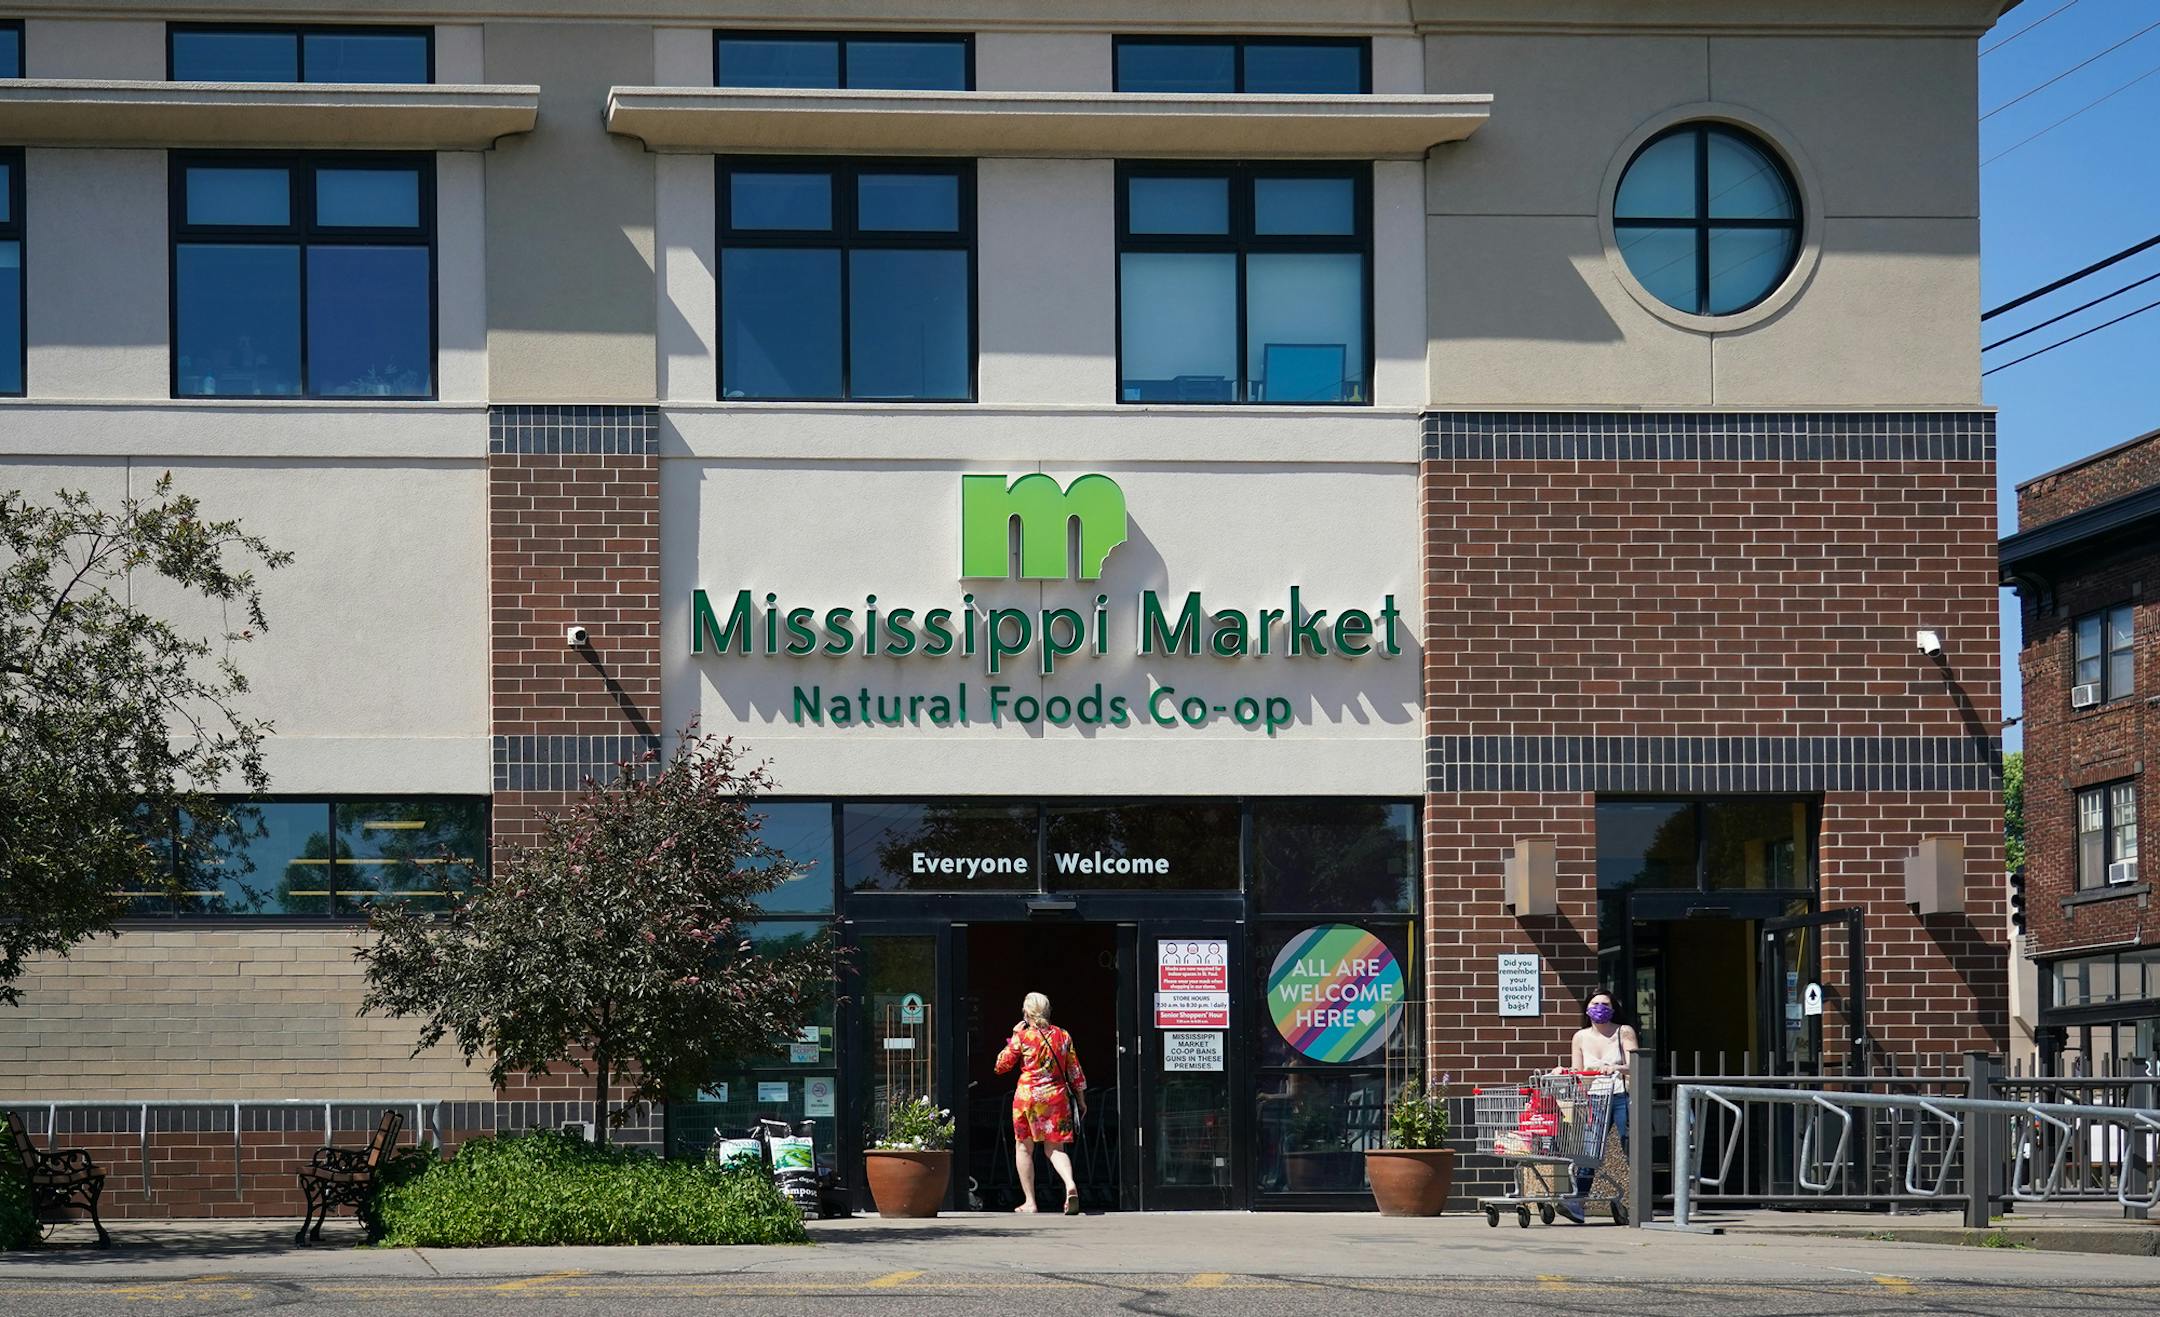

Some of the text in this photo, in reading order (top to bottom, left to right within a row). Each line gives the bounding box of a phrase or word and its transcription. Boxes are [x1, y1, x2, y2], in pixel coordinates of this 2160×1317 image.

[691, 585, 1402, 676] Mississippi Market
[792, 683, 1292, 735] Natural Foods Co-op
[912, 851, 1170, 879] Everyone Welcome
[1292, 959, 1380, 977] ALL ARE
[1279, 984, 1393, 1002] WELCOME
[1504, 994, 1532, 1002] grocery
[1296, 1009, 1355, 1027] HERE
